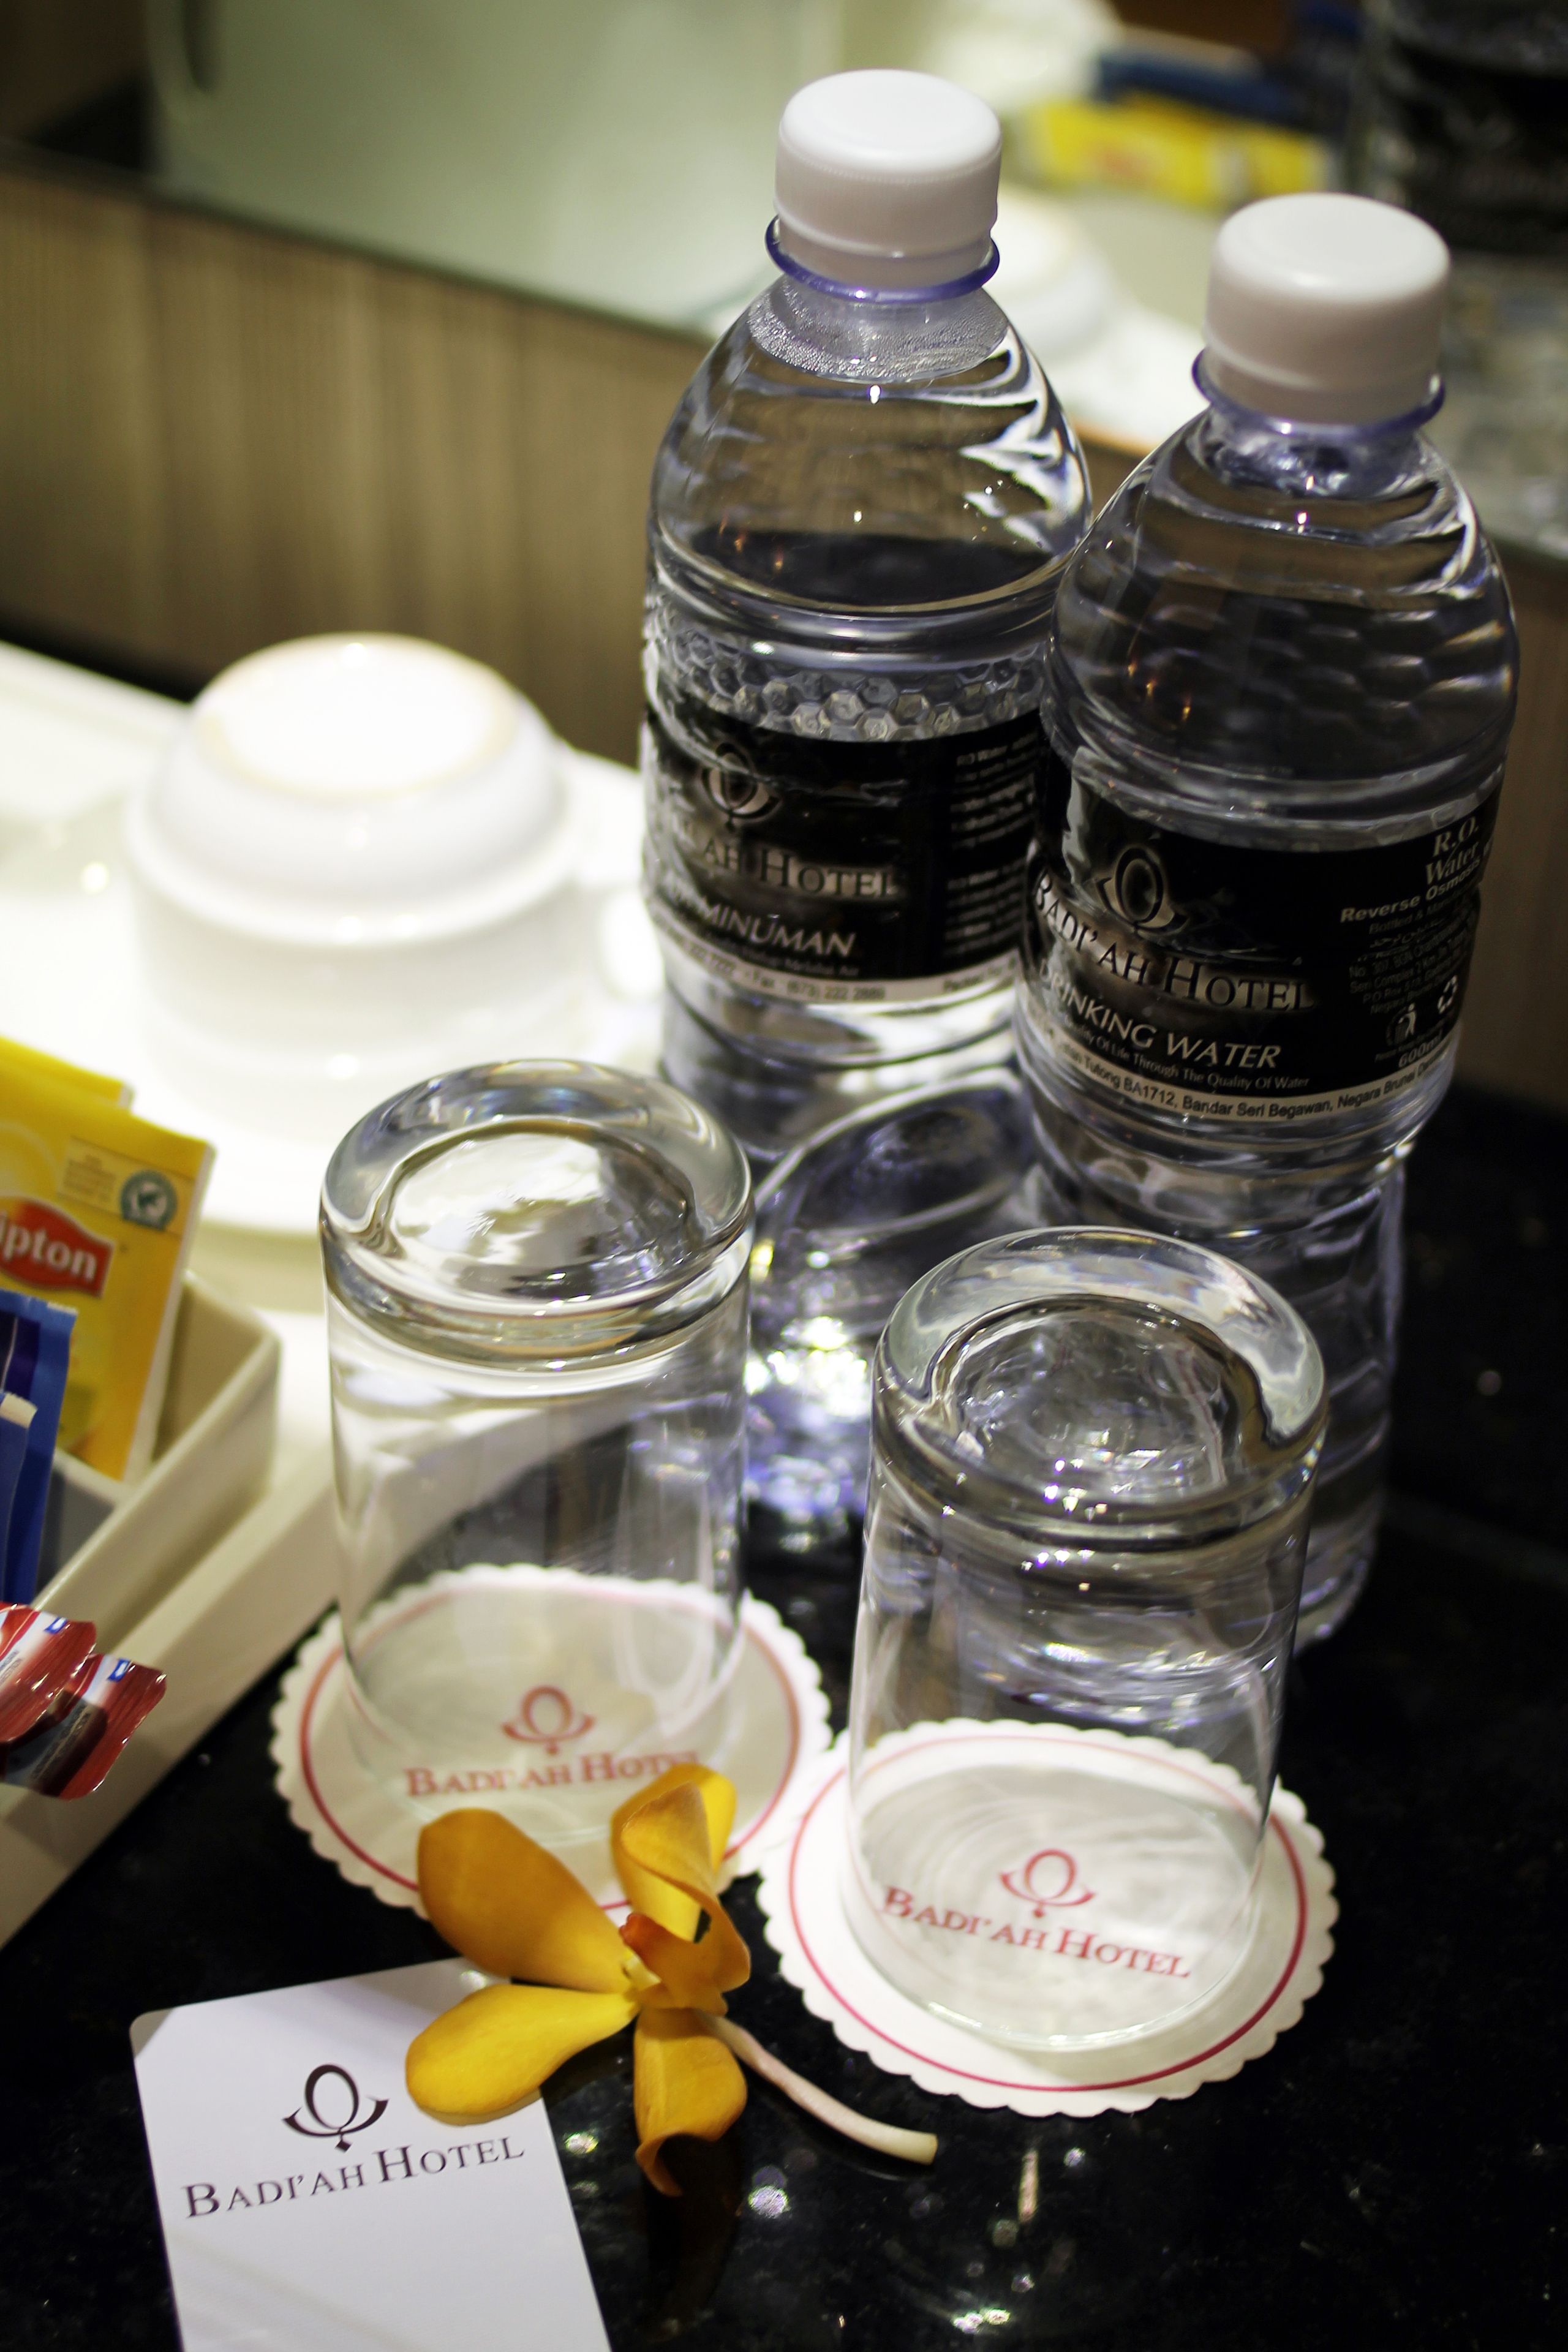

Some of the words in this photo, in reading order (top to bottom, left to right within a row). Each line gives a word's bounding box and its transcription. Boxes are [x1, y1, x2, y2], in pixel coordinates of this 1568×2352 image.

[1432, 816, 1480, 858] R.O.
[760, 848, 899, 897] HOTEL
[1425, 841, 1480, 886] Water
[1340, 894, 1422, 924] Reverse
[1163, 956, 1314, 1011] HOTEL
[1133, 1051, 1180, 1079] Through
[1183, 1066, 1205, 1084] The
[1207, 1072, 1254, 1094] Quality
[1255, 1076, 1272, 1090] Of
[1273, 1076, 1311, 1091] Water
[1166, 1032, 1283, 1069] WATER
[1182, 1095, 1234, 1115] Bandar
[1237, 1102, 1265, 1117] Seri
[1268, 1100, 1333, 1120] Begawan,
[1337, 1087, 1381, 1110] Negara
[1054, 1928, 1191, 1978] HOTEL
[181, 2163, 366, 2219] BADI'AH
[372, 2136, 525, 2184] HOTEL
